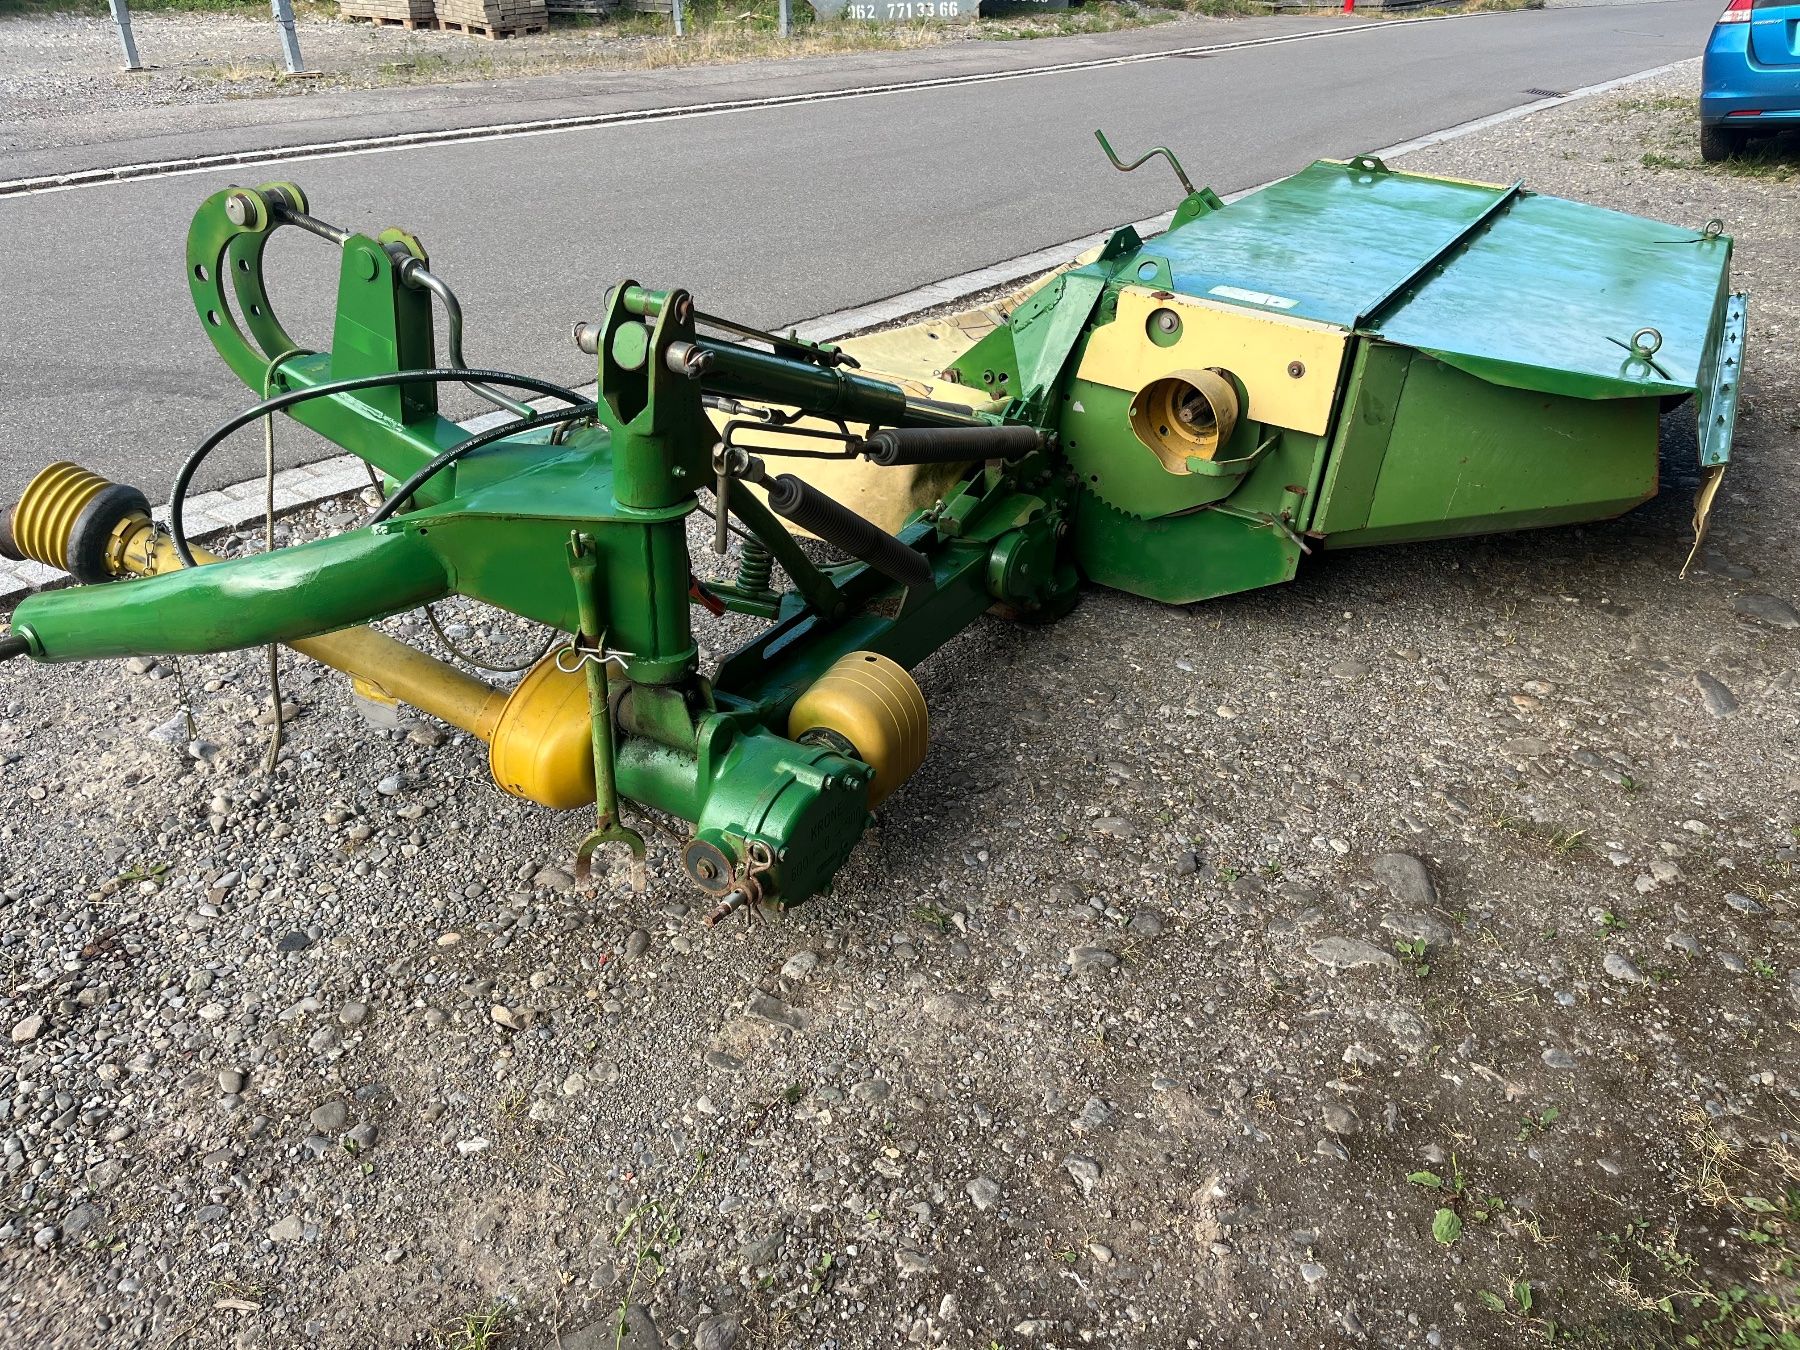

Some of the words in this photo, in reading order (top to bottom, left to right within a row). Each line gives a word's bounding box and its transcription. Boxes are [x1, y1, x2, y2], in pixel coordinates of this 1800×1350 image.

[887, 3, 912, 18] 771
[916, 2, 935, 17] 33
[940, 1, 958, 17] 66
[810, 800, 845, 842] KRONE
